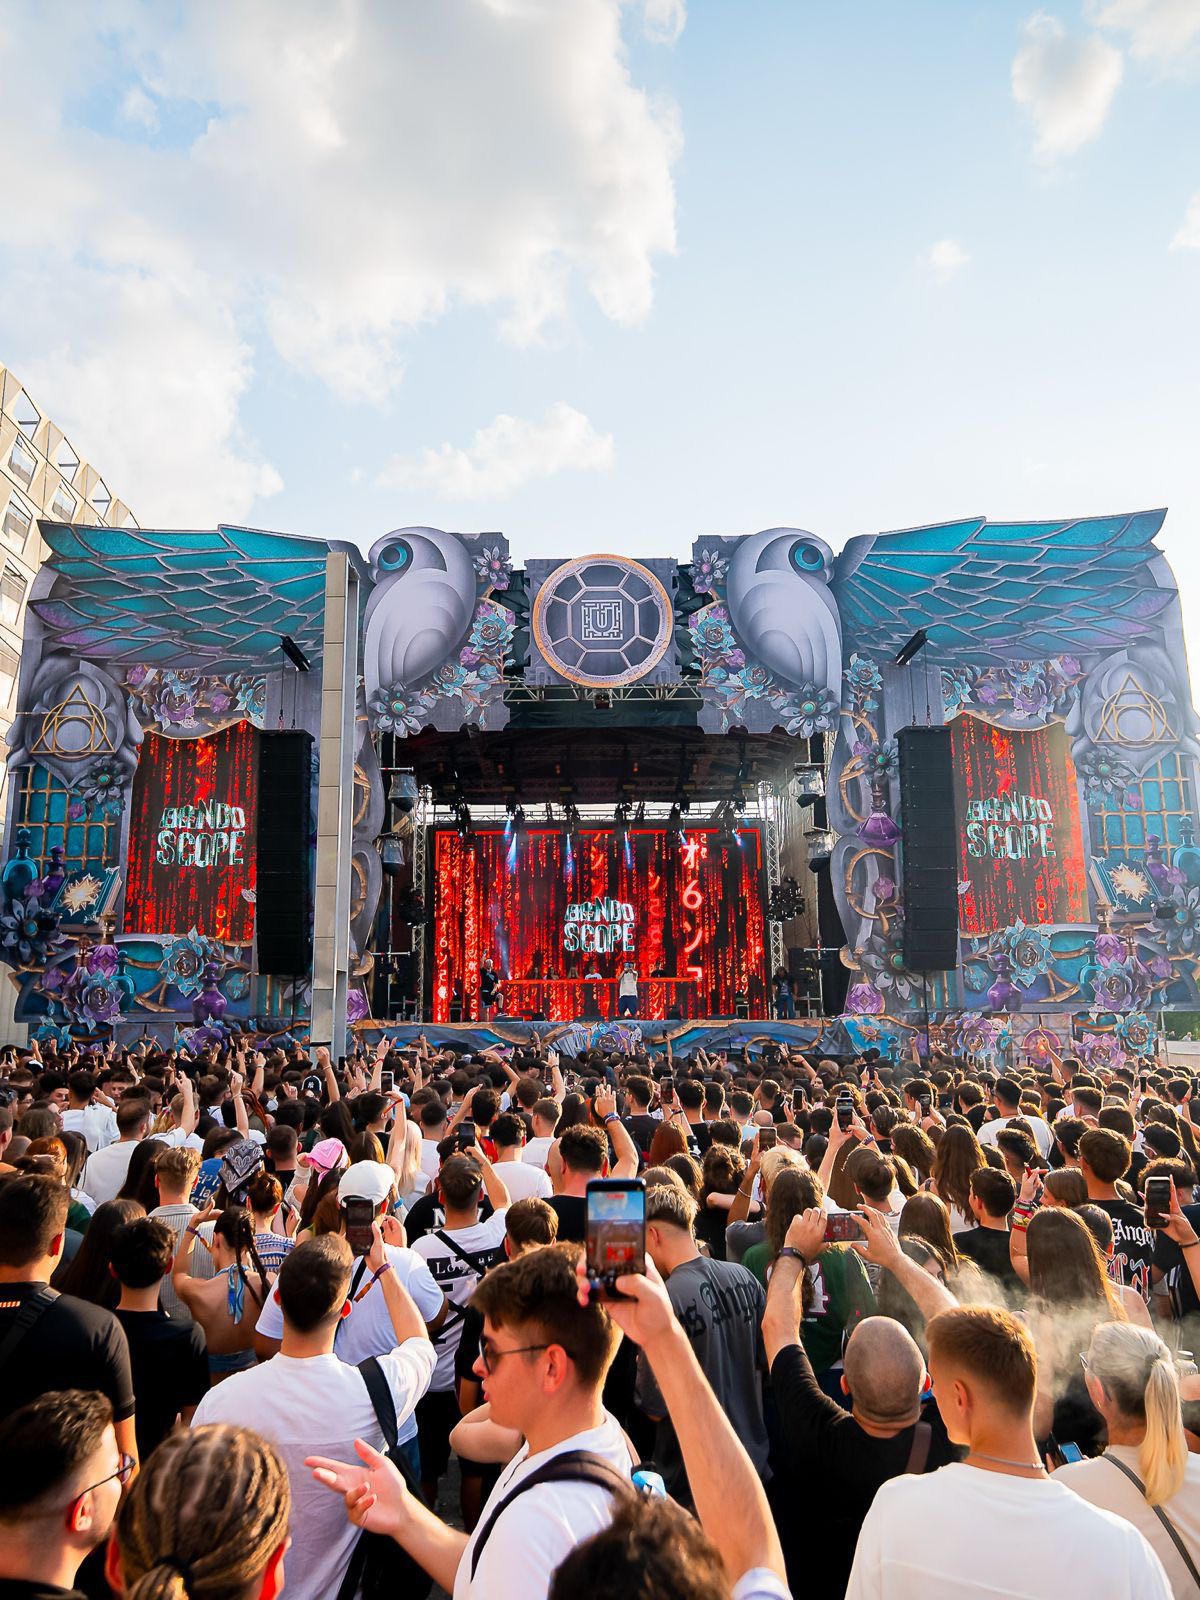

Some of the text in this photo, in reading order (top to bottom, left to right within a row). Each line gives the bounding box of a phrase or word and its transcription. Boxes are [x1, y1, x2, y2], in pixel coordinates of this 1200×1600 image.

[156, 830, 246, 868] SCOPE
[966, 822, 1057, 860] SCOPE
[564, 922, 635, 954] SCOPE
